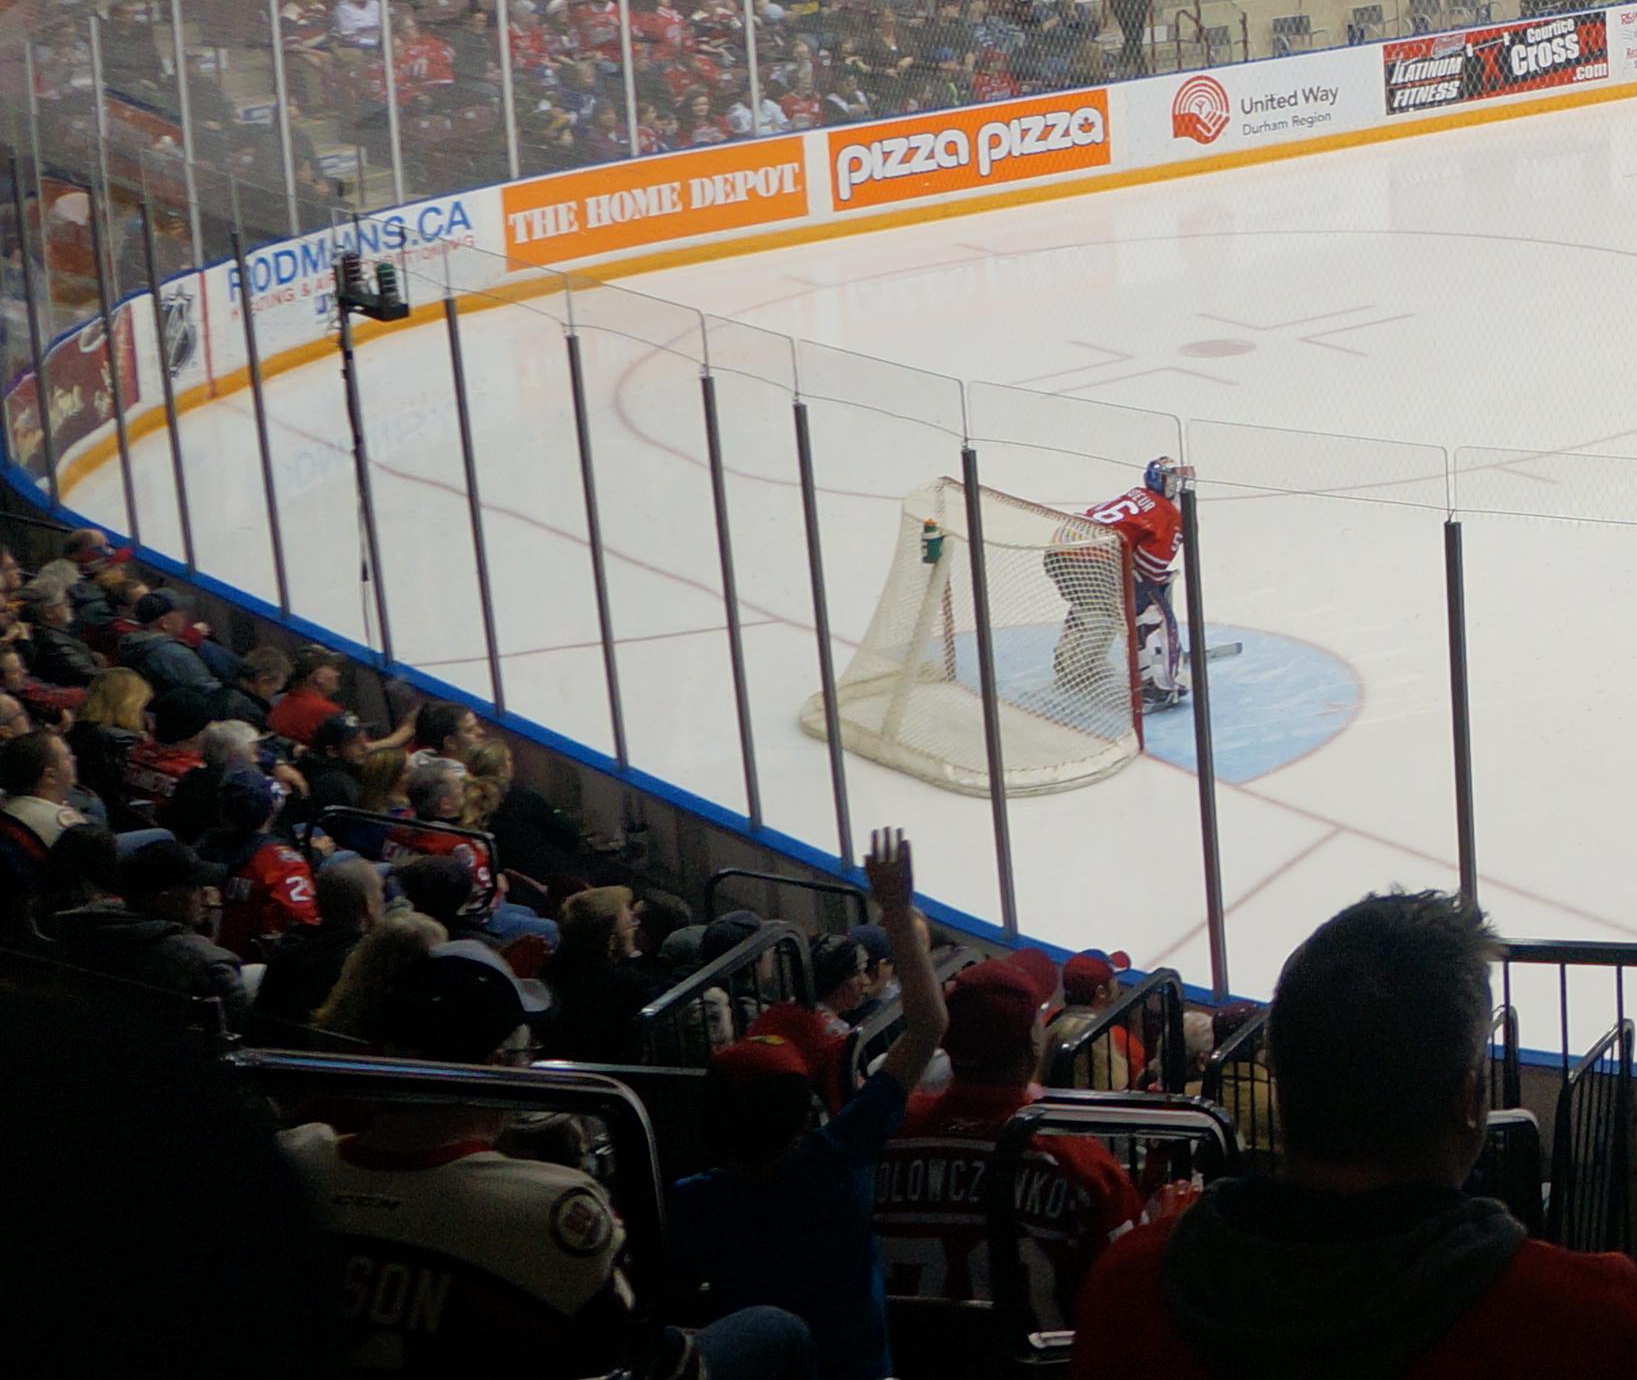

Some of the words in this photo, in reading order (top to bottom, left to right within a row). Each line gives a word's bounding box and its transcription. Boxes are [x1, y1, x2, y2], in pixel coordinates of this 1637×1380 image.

[1526, 18, 1575, 44] Courtice
[1511, 33, 1580, 77] Cross
[1573, 62, 1608, 82] .com
[1240, 92, 1299, 116] United
[1303, 84, 1340, 109] Way
[1393, 81, 1461, 109] FITNESS
[1242, 118, 1295, 137] Durham
[1297, 110, 1332, 132] Region
[836, 129, 969, 201] pizza
[978, 107, 1104, 176] pizza
[508, 201, 578, 245] THE
[585, 182, 682, 226] HOME
[690, 162, 803, 211] DEPOT
